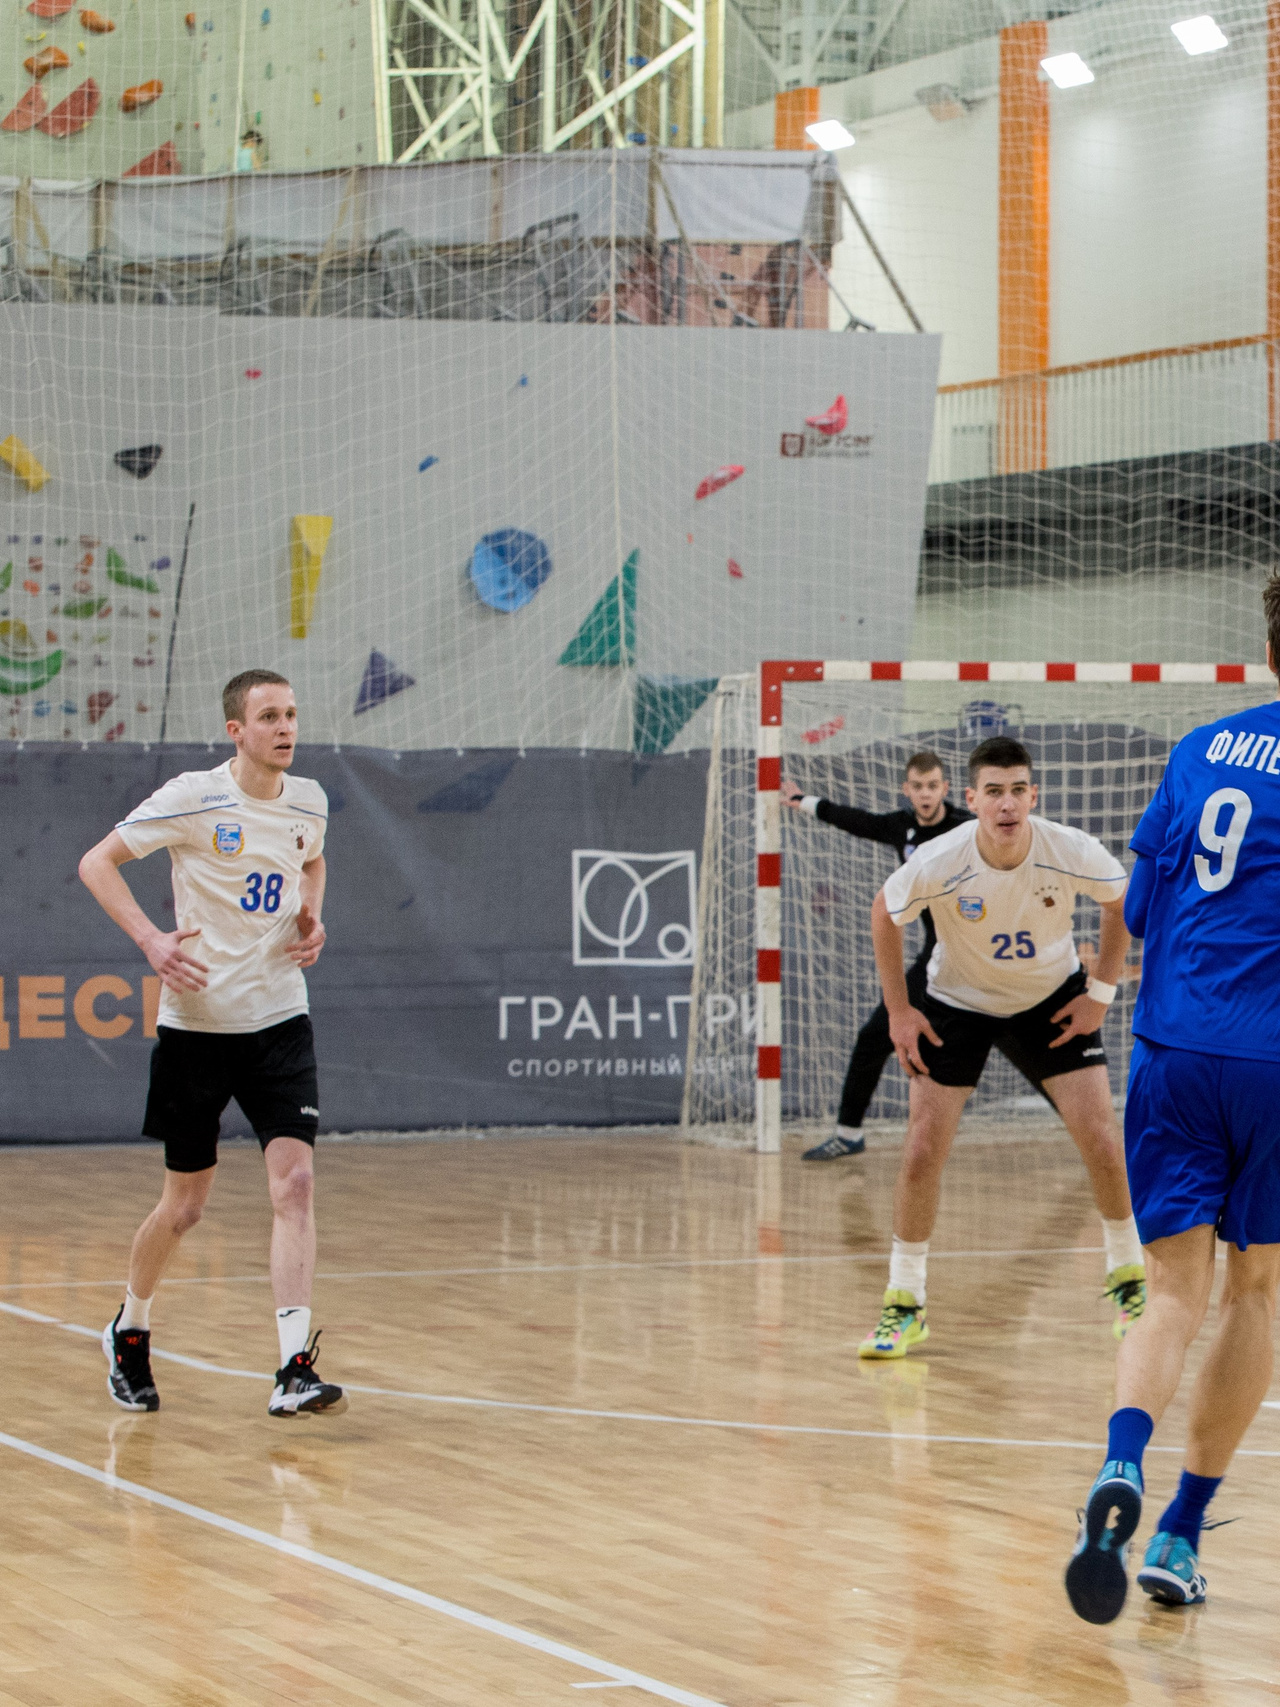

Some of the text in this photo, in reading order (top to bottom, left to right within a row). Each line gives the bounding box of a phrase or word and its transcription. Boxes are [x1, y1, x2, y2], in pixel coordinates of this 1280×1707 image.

[1194, 787, 1252, 892] 9
[240, 872, 284, 913] 38
[991, 931, 1036, 960] 25
[508, 1053, 683, 1078] СПОРТИВНЫЙ
